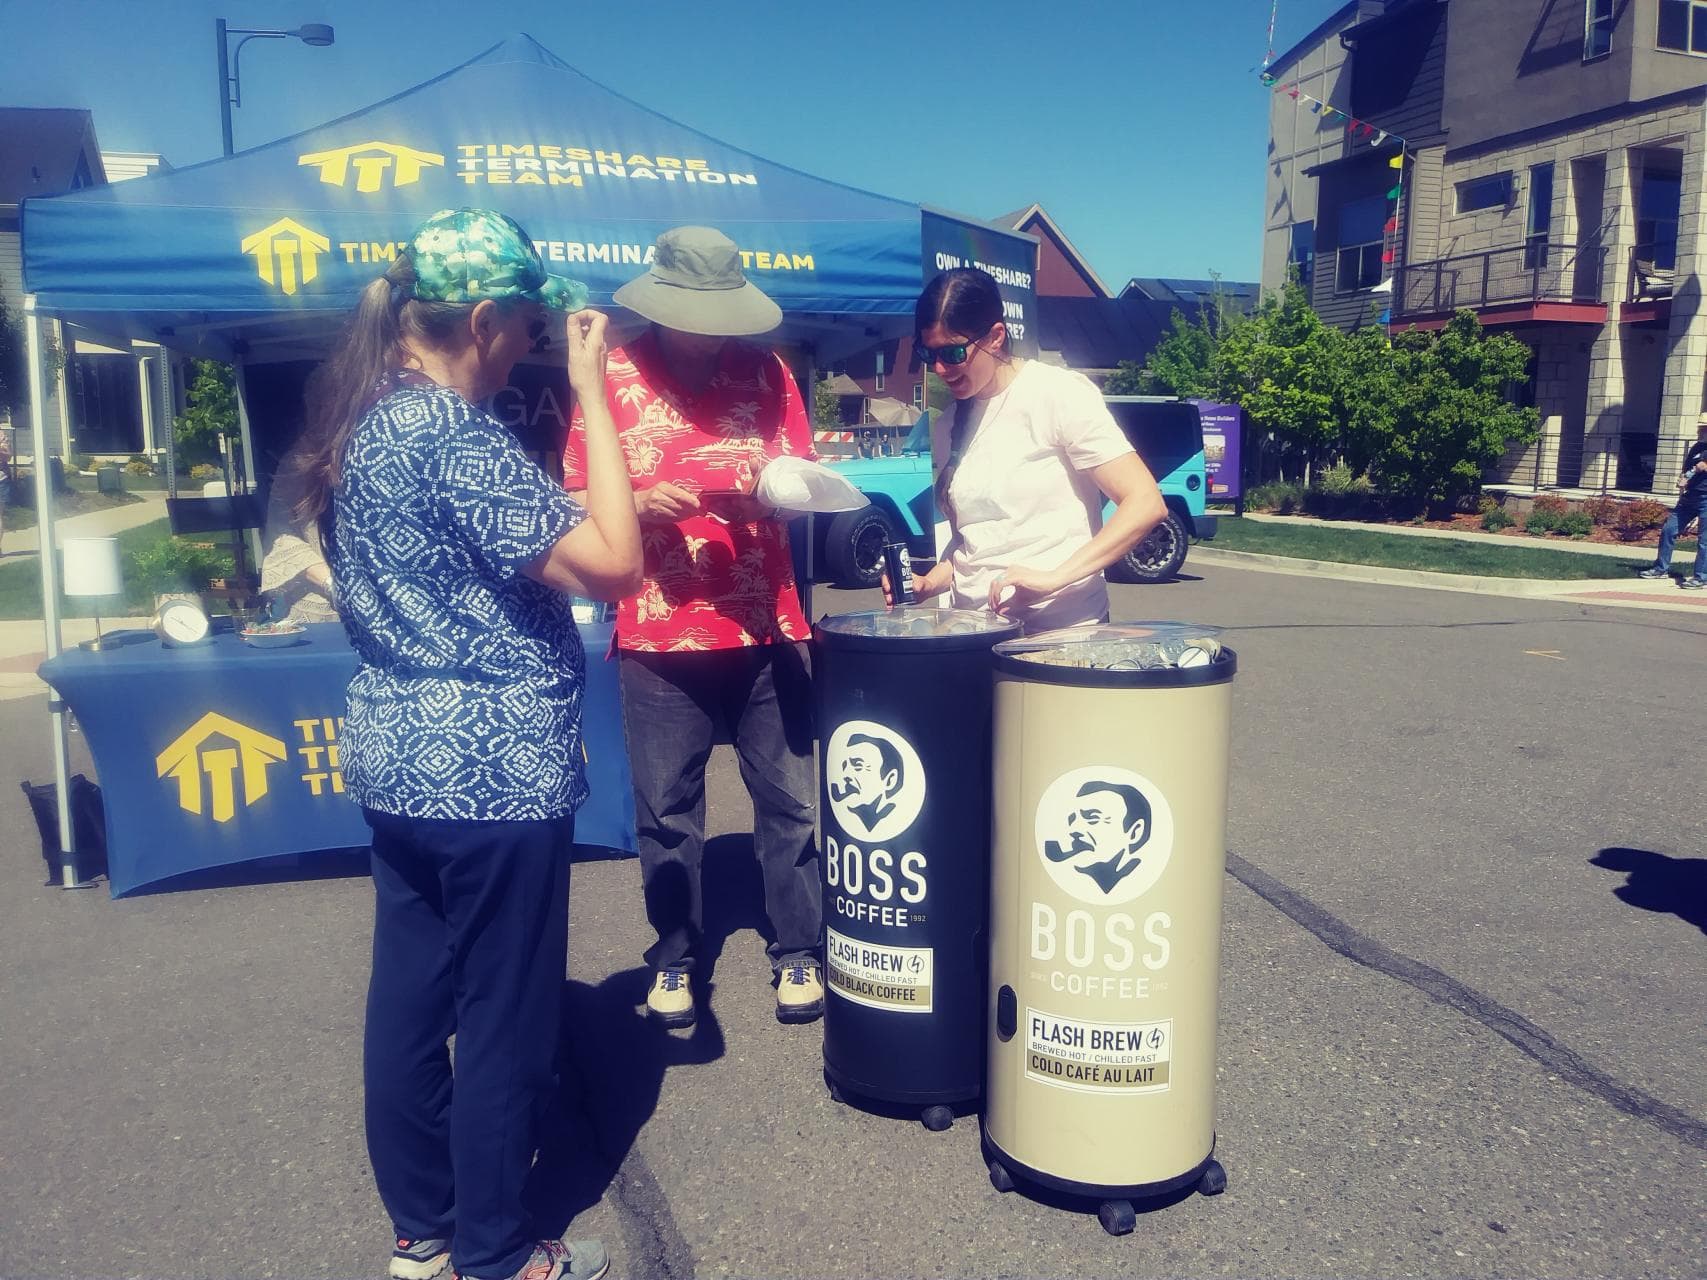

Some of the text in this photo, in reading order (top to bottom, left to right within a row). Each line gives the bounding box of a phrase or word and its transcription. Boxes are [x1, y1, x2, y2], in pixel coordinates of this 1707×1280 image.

[457, 144, 710, 171] TIMESHARE
[457, 157, 758, 185] TERMINATION
[456, 171, 584, 187] TEAM
[339, 241, 406, 264] TIM
[738, 250, 815, 271] TEAM
[935, 252, 960, 271] OWN
[827, 835, 927, 904] BOSS
[836, 895, 909, 927] COFFEE
[910, 914, 926, 922] 1992
[1031, 902, 1172, 972] BOSS
[829, 935, 904, 973] FLASH BREW
[829, 967, 916, 1001] COLD BLACK COFFEE
[849, 966, 860, 975] HOT
[865, 973, 896, 983] CHILLED
[898, 977, 918, 985] FAST
[1050, 971, 1150, 999] COFFEE
[1032, 1017, 1142, 1051] FLASH BREW
[1032, 1041, 1067, 1058] BREWED
[1069, 1051, 1087, 1061] HOT
[1094, 1054, 1133, 1064] CHILLED
[1135, 1054, 1157, 1063] FAST
[1032, 1055, 1155, 1083] COLD CAFÉ AU LAIT
